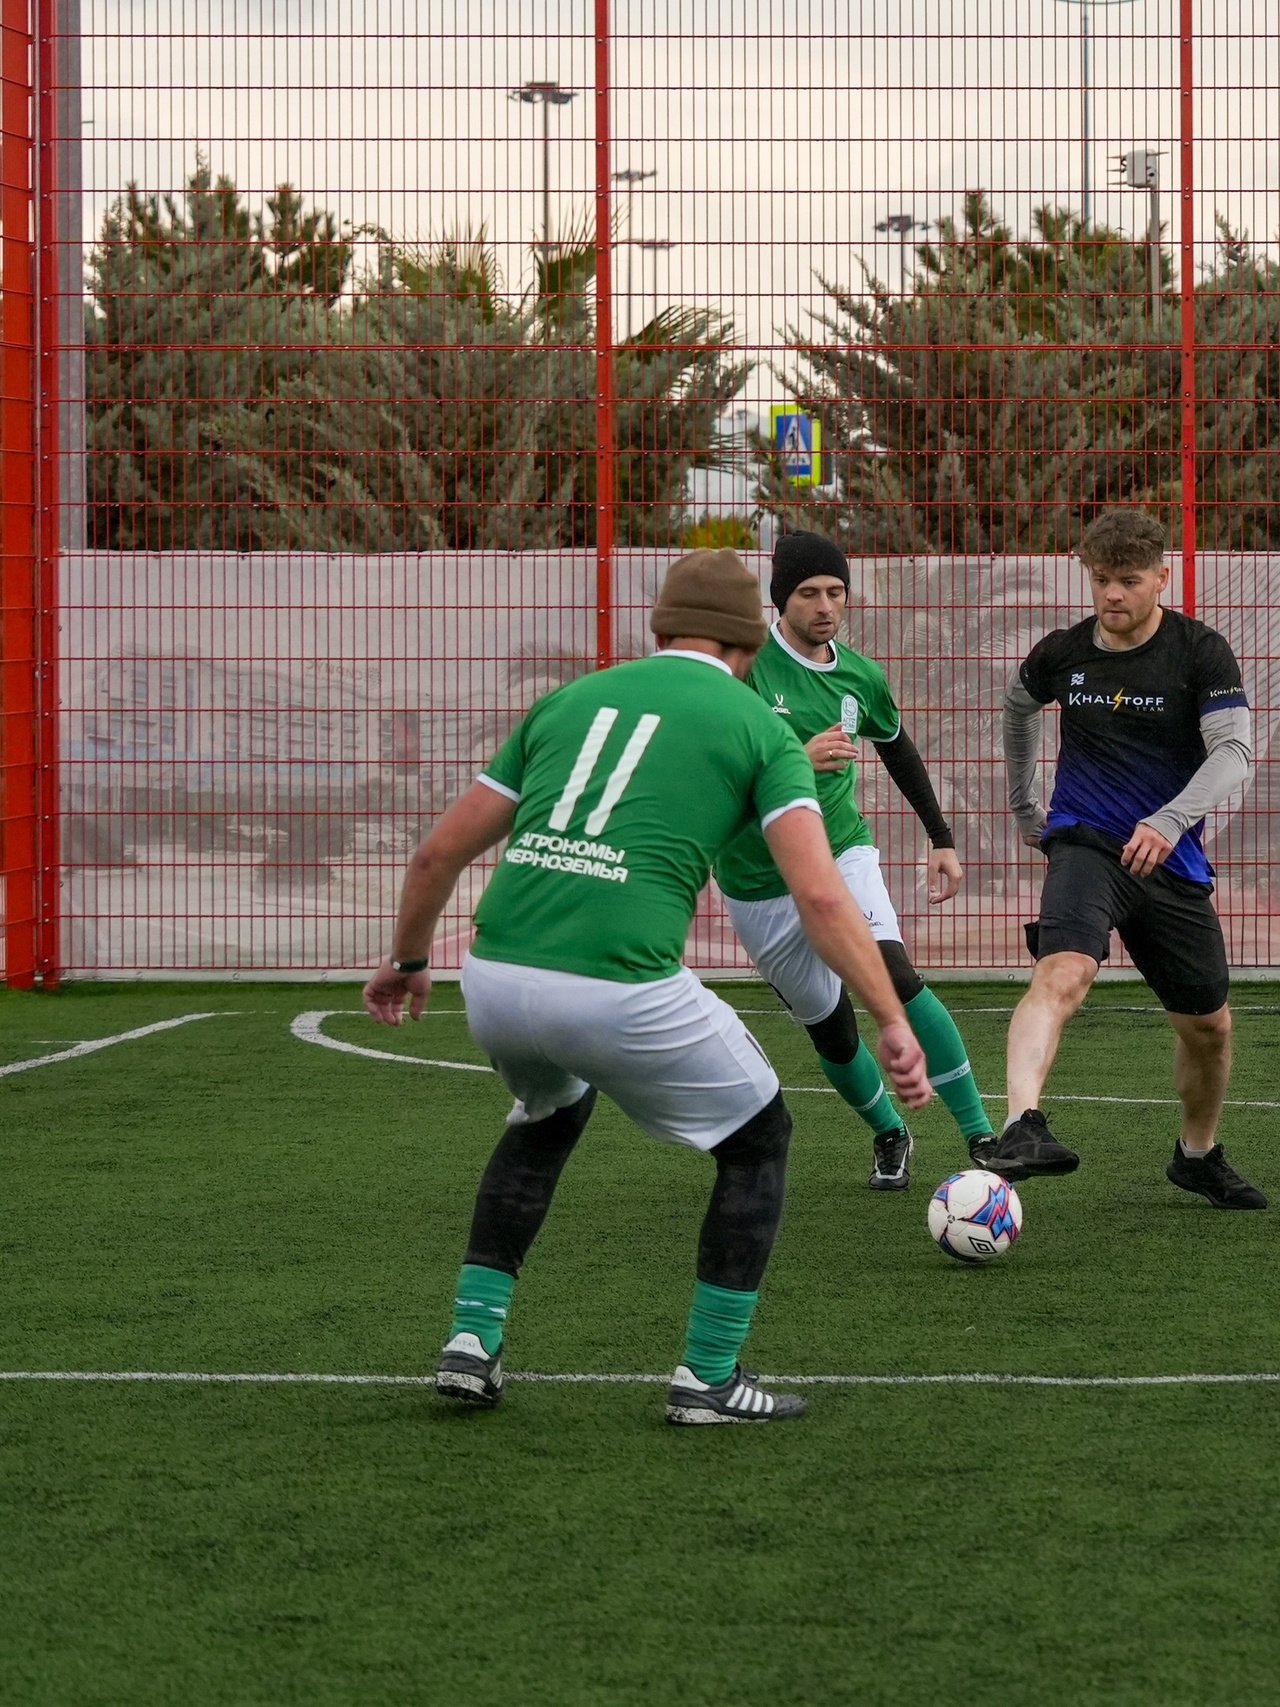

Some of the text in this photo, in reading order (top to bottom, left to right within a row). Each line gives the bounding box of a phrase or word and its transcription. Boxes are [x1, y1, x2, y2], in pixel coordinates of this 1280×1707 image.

[548, 706, 661, 836] 11
[505, 848, 629, 883] ЧЕРНОЗЕМЬЯ
[516, 832, 626, 864] АГРОНОМЫ
